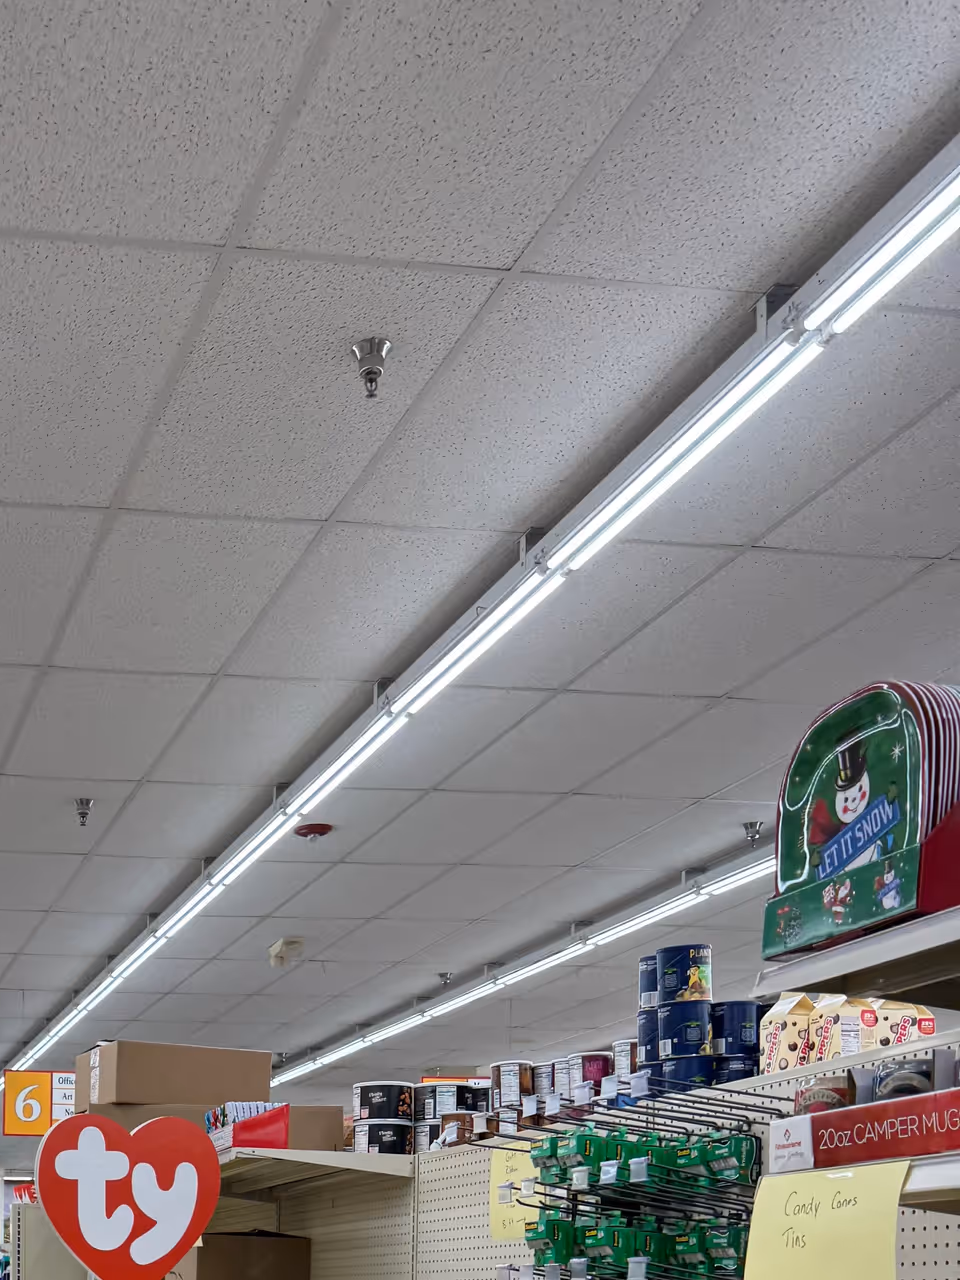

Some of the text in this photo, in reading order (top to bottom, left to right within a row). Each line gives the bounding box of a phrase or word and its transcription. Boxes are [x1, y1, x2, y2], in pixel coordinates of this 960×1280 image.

[819, 799, 893, 879] LET IT SNOW
[58, 1076, 76, 1085] Offic
[14, 1084, 42, 1123] 6
[62, 1092, 73, 1101] Art
[818, 1128, 852, 1150] 20oz
[853, 1114, 920, 1145] CAMPER
[54, 1126, 199, 1266] ty
[784, 1191, 821, 1218] Candy
[781, 1227, 807, 1248] Tins
